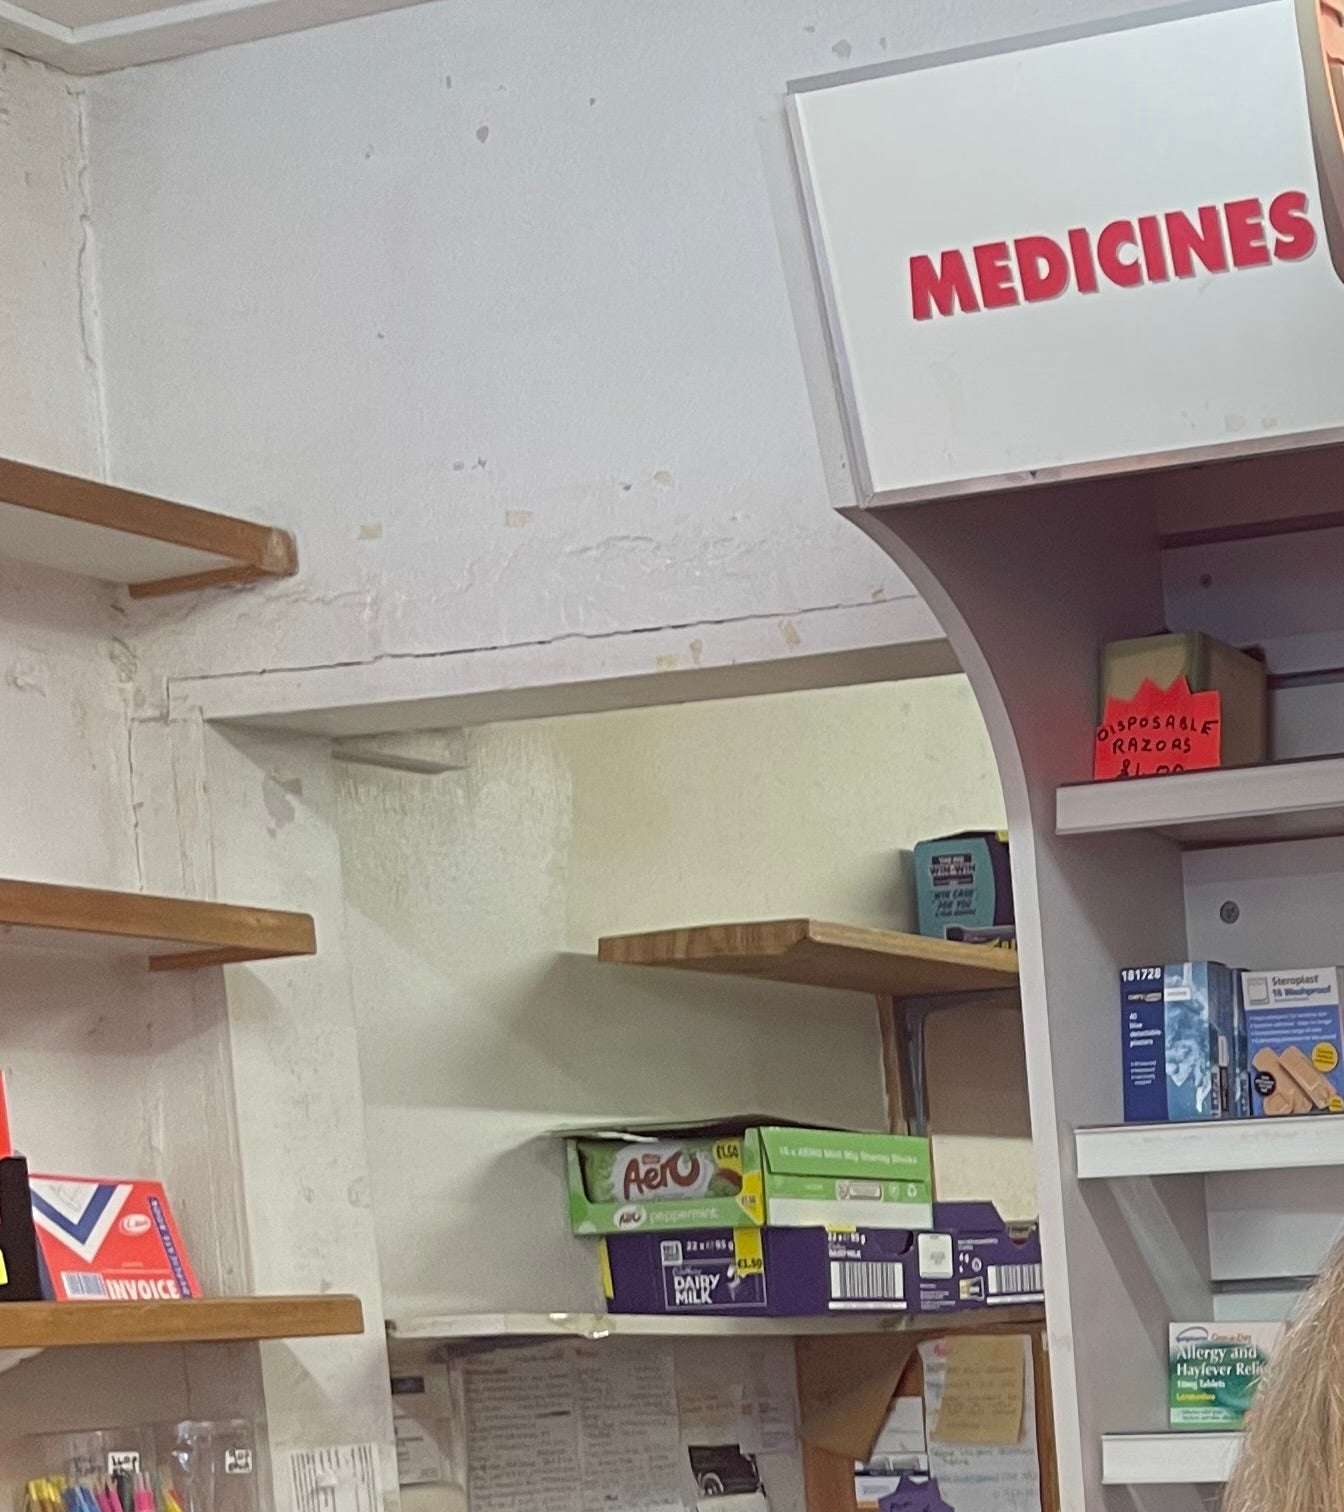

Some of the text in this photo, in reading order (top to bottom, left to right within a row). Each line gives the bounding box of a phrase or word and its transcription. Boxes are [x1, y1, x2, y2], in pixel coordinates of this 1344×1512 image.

[909, 191, 1317, 321] MEDICINES
[1097, 714, 1219, 742] DISPOSABLE
[1112, 737, 1191, 754] RAZORS
[1121, 967, 1162, 982] 181728
[1272, 975, 1319, 986] Steroplast
[717, 1144, 740, 1159] £1.50
[623, 1151, 700, 1201] Aero
[737, 1258, 762, 1270] £1.50
[106, 1279, 181, 1301] INVOICE
[674, 1274, 721, 1291] DAIRY
[675, 1286, 713, 1306] MILK
[1177, 1343, 1257, 1363] Allergy and
[1177, 1361, 1265, 1379] Hayfever Reli
